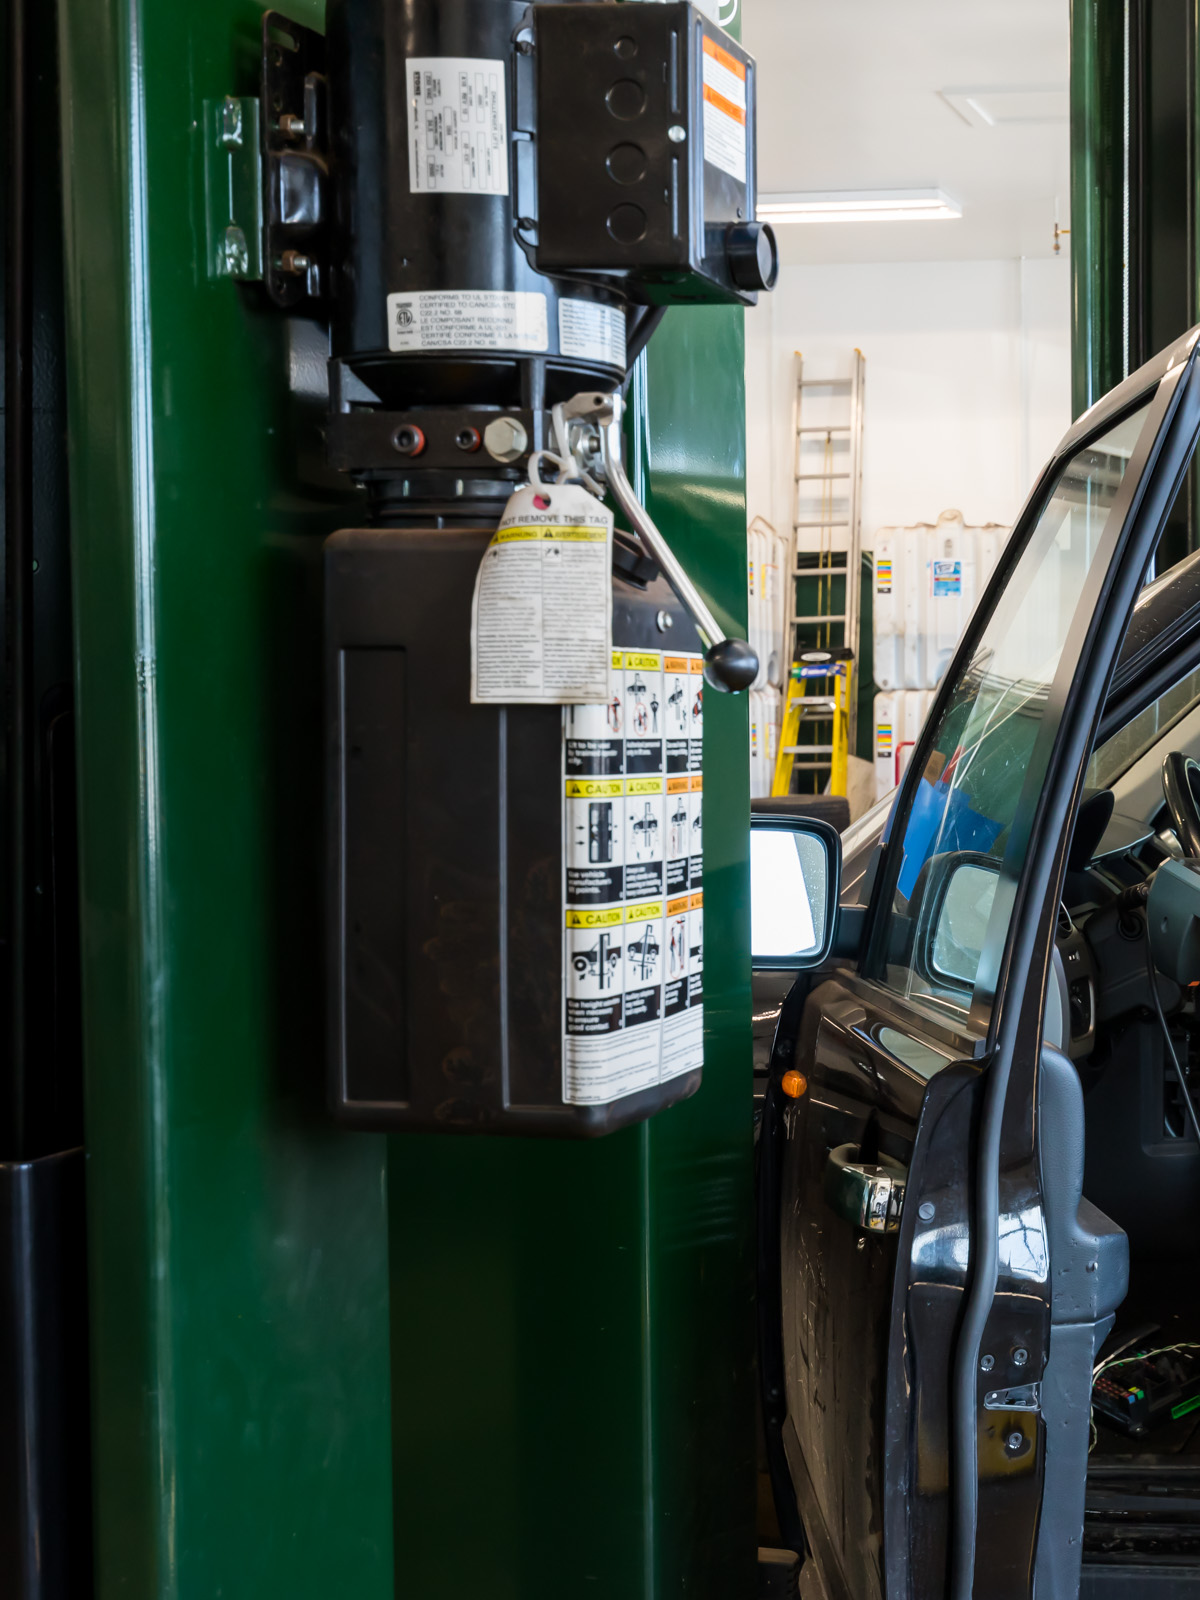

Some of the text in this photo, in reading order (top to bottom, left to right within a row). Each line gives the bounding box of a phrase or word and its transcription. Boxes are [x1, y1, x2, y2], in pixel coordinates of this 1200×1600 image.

[518, 515, 560, 524] REMOVE
[635, 657, 658, 667] CAUTION
[586, 784, 620, 794] CAUTION
[636, 781, 660, 791] CAUTION
[636, 906, 660, 917] CAUTION
[586, 912, 620, 924] CAUTION
